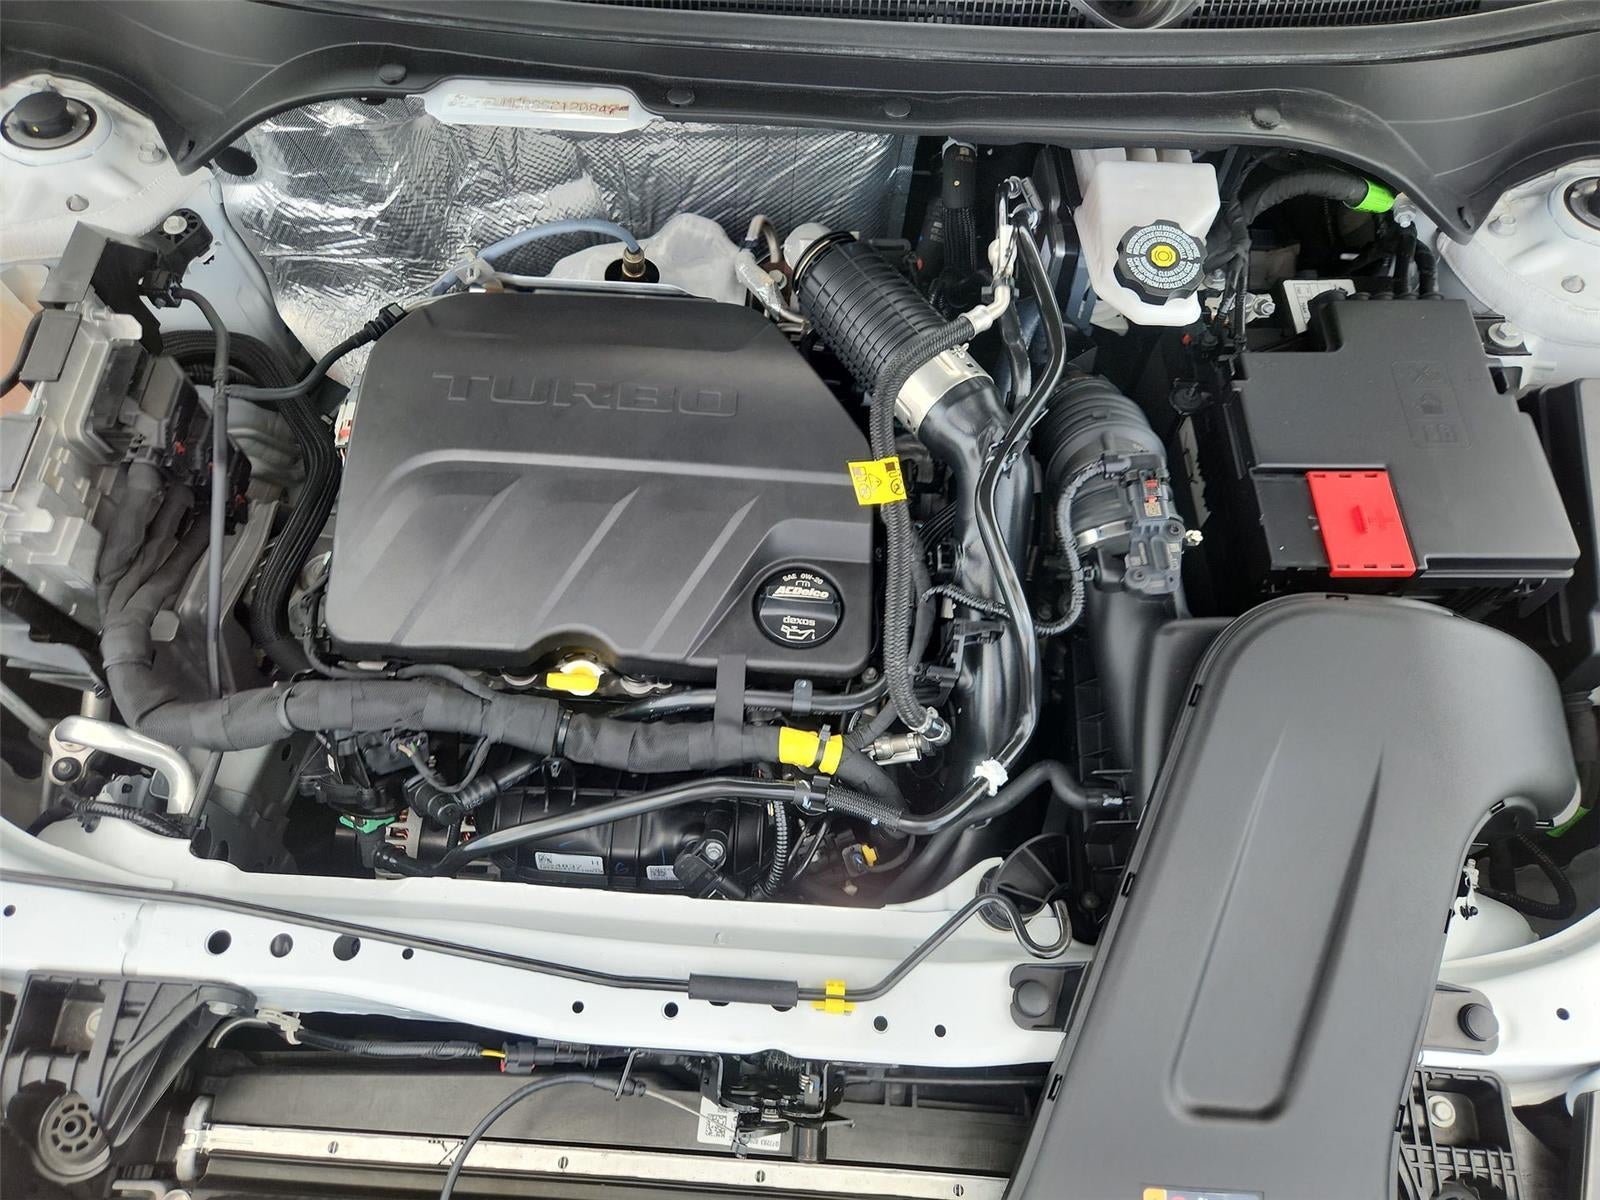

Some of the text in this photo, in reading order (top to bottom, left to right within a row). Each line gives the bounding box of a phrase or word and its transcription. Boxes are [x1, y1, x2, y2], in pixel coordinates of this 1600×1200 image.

[432, 371, 739, 417] TURBO
[782, 573, 824, 585] SAE 0W-20
[773, 586, 829, 599] ACDelco
[783, 616, 816, 627] dexos
